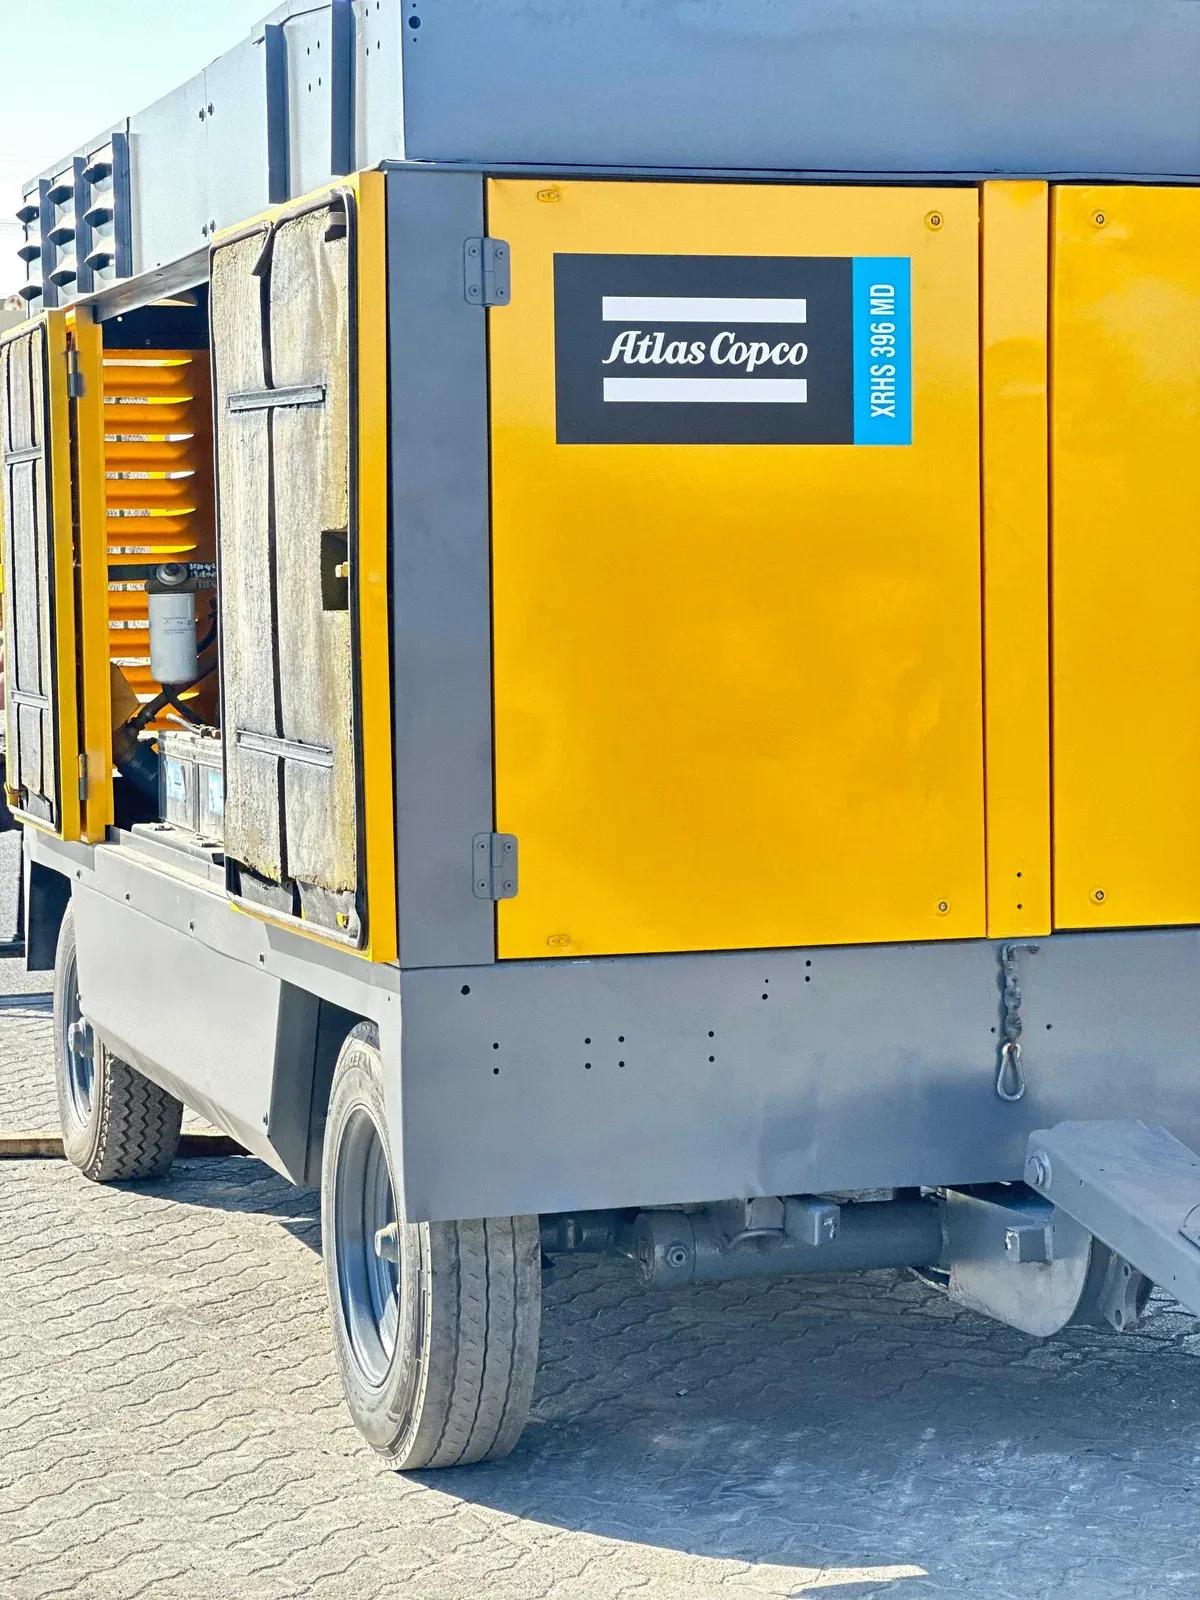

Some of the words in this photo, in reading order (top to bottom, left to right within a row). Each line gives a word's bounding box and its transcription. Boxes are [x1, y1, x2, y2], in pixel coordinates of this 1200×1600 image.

[870, 284, 895, 315] MD
[602, 330, 706, 365] Atlas
[710, 331, 808, 373] Copco
[870, 322, 895, 358] 396
[870, 364, 896, 418] XRHS
